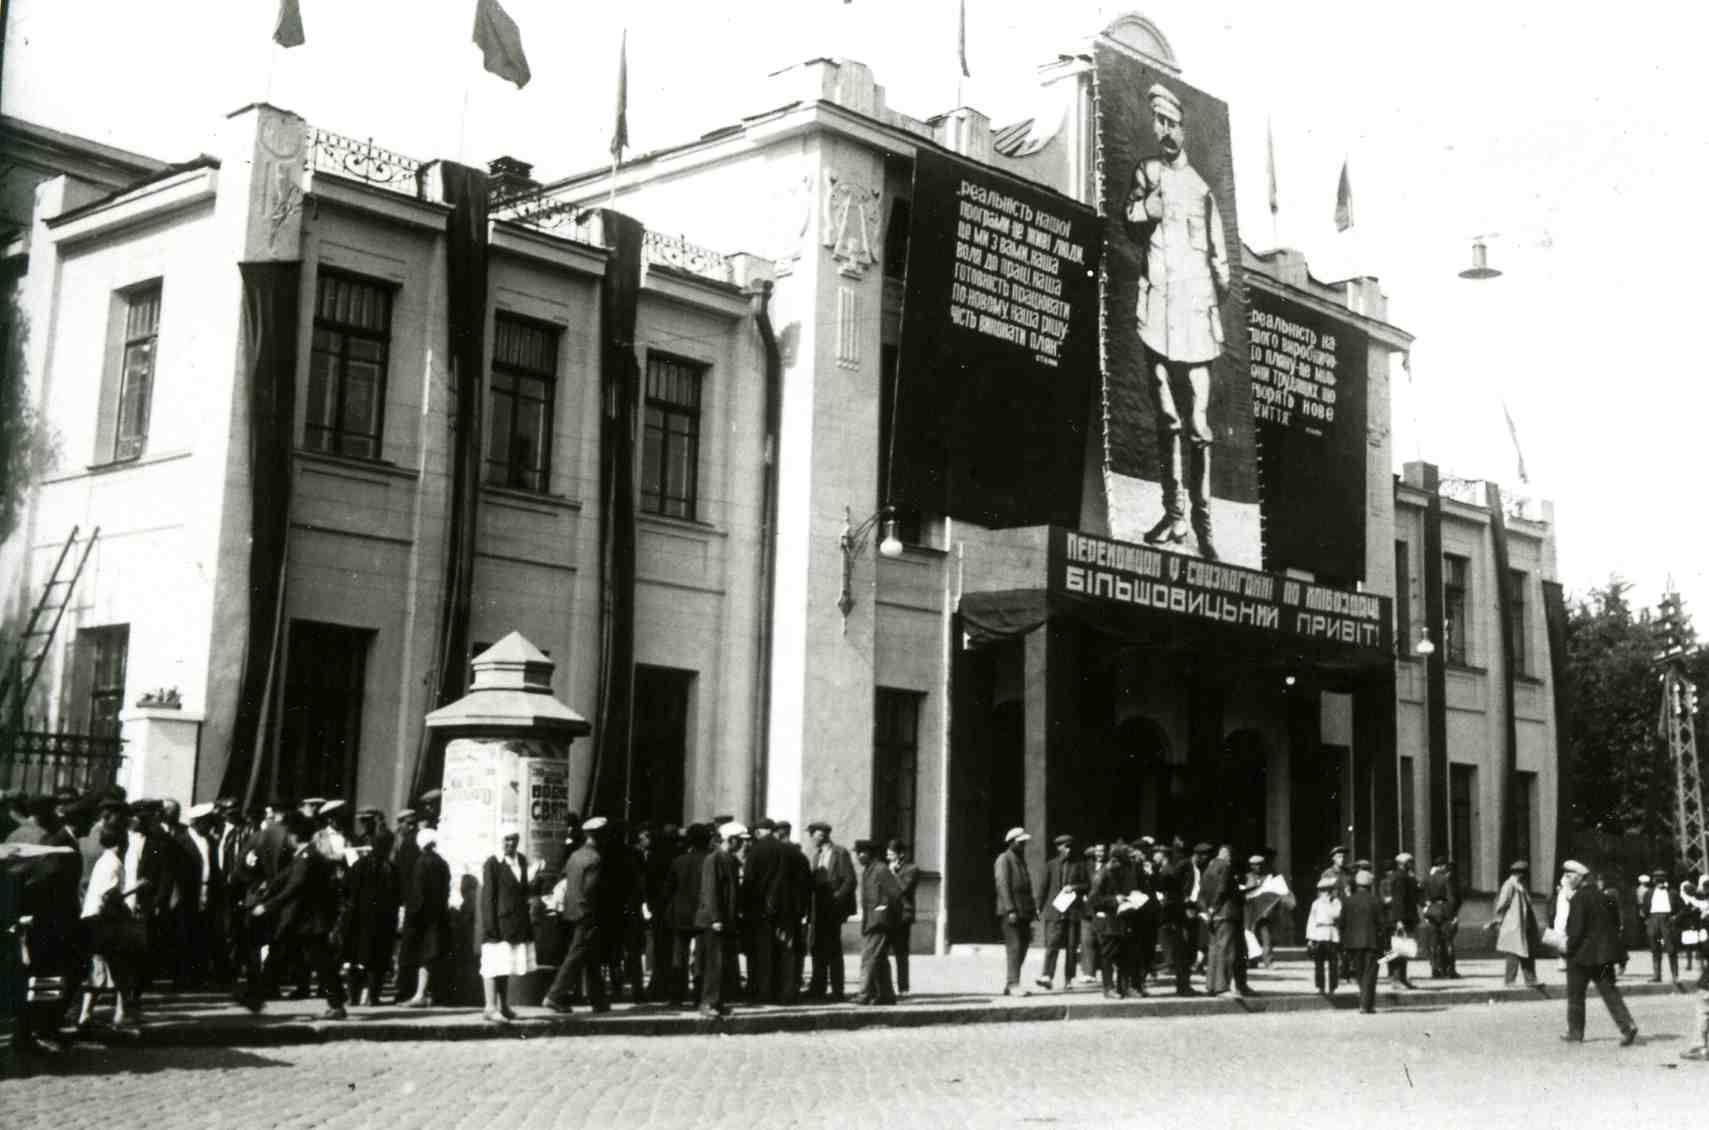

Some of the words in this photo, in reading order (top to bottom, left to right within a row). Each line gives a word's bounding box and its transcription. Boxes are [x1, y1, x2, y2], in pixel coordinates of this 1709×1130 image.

[957, 219, 972, 240] це
[972, 226, 990, 248] ми
[990, 233, 999, 251] з
[1030, 249, 1060, 276] наша
[1011, 220, 1025, 240] це
[1034, 209, 1072, 239] нашої
[954, 261, 1011, 298] готовність
[1011, 283, 1071, 321] працювати
[956, 241, 982, 266] воля
[983, 252, 1000, 272] до
[1032, 270, 1063, 297] наша
[1010, 302, 1040, 330] наша
[1302, 399, 1334, 422] нове
[1066, 531, 1163, 579] ПЕРЕМОЖЦЯМ
[1283, 580, 1301, 606] ПО
[1065, 564, 1280, 630] БІЛЬШОВИЦЬКИЙ
[1296, 611, 1381, 648] ПРИВІТ!
